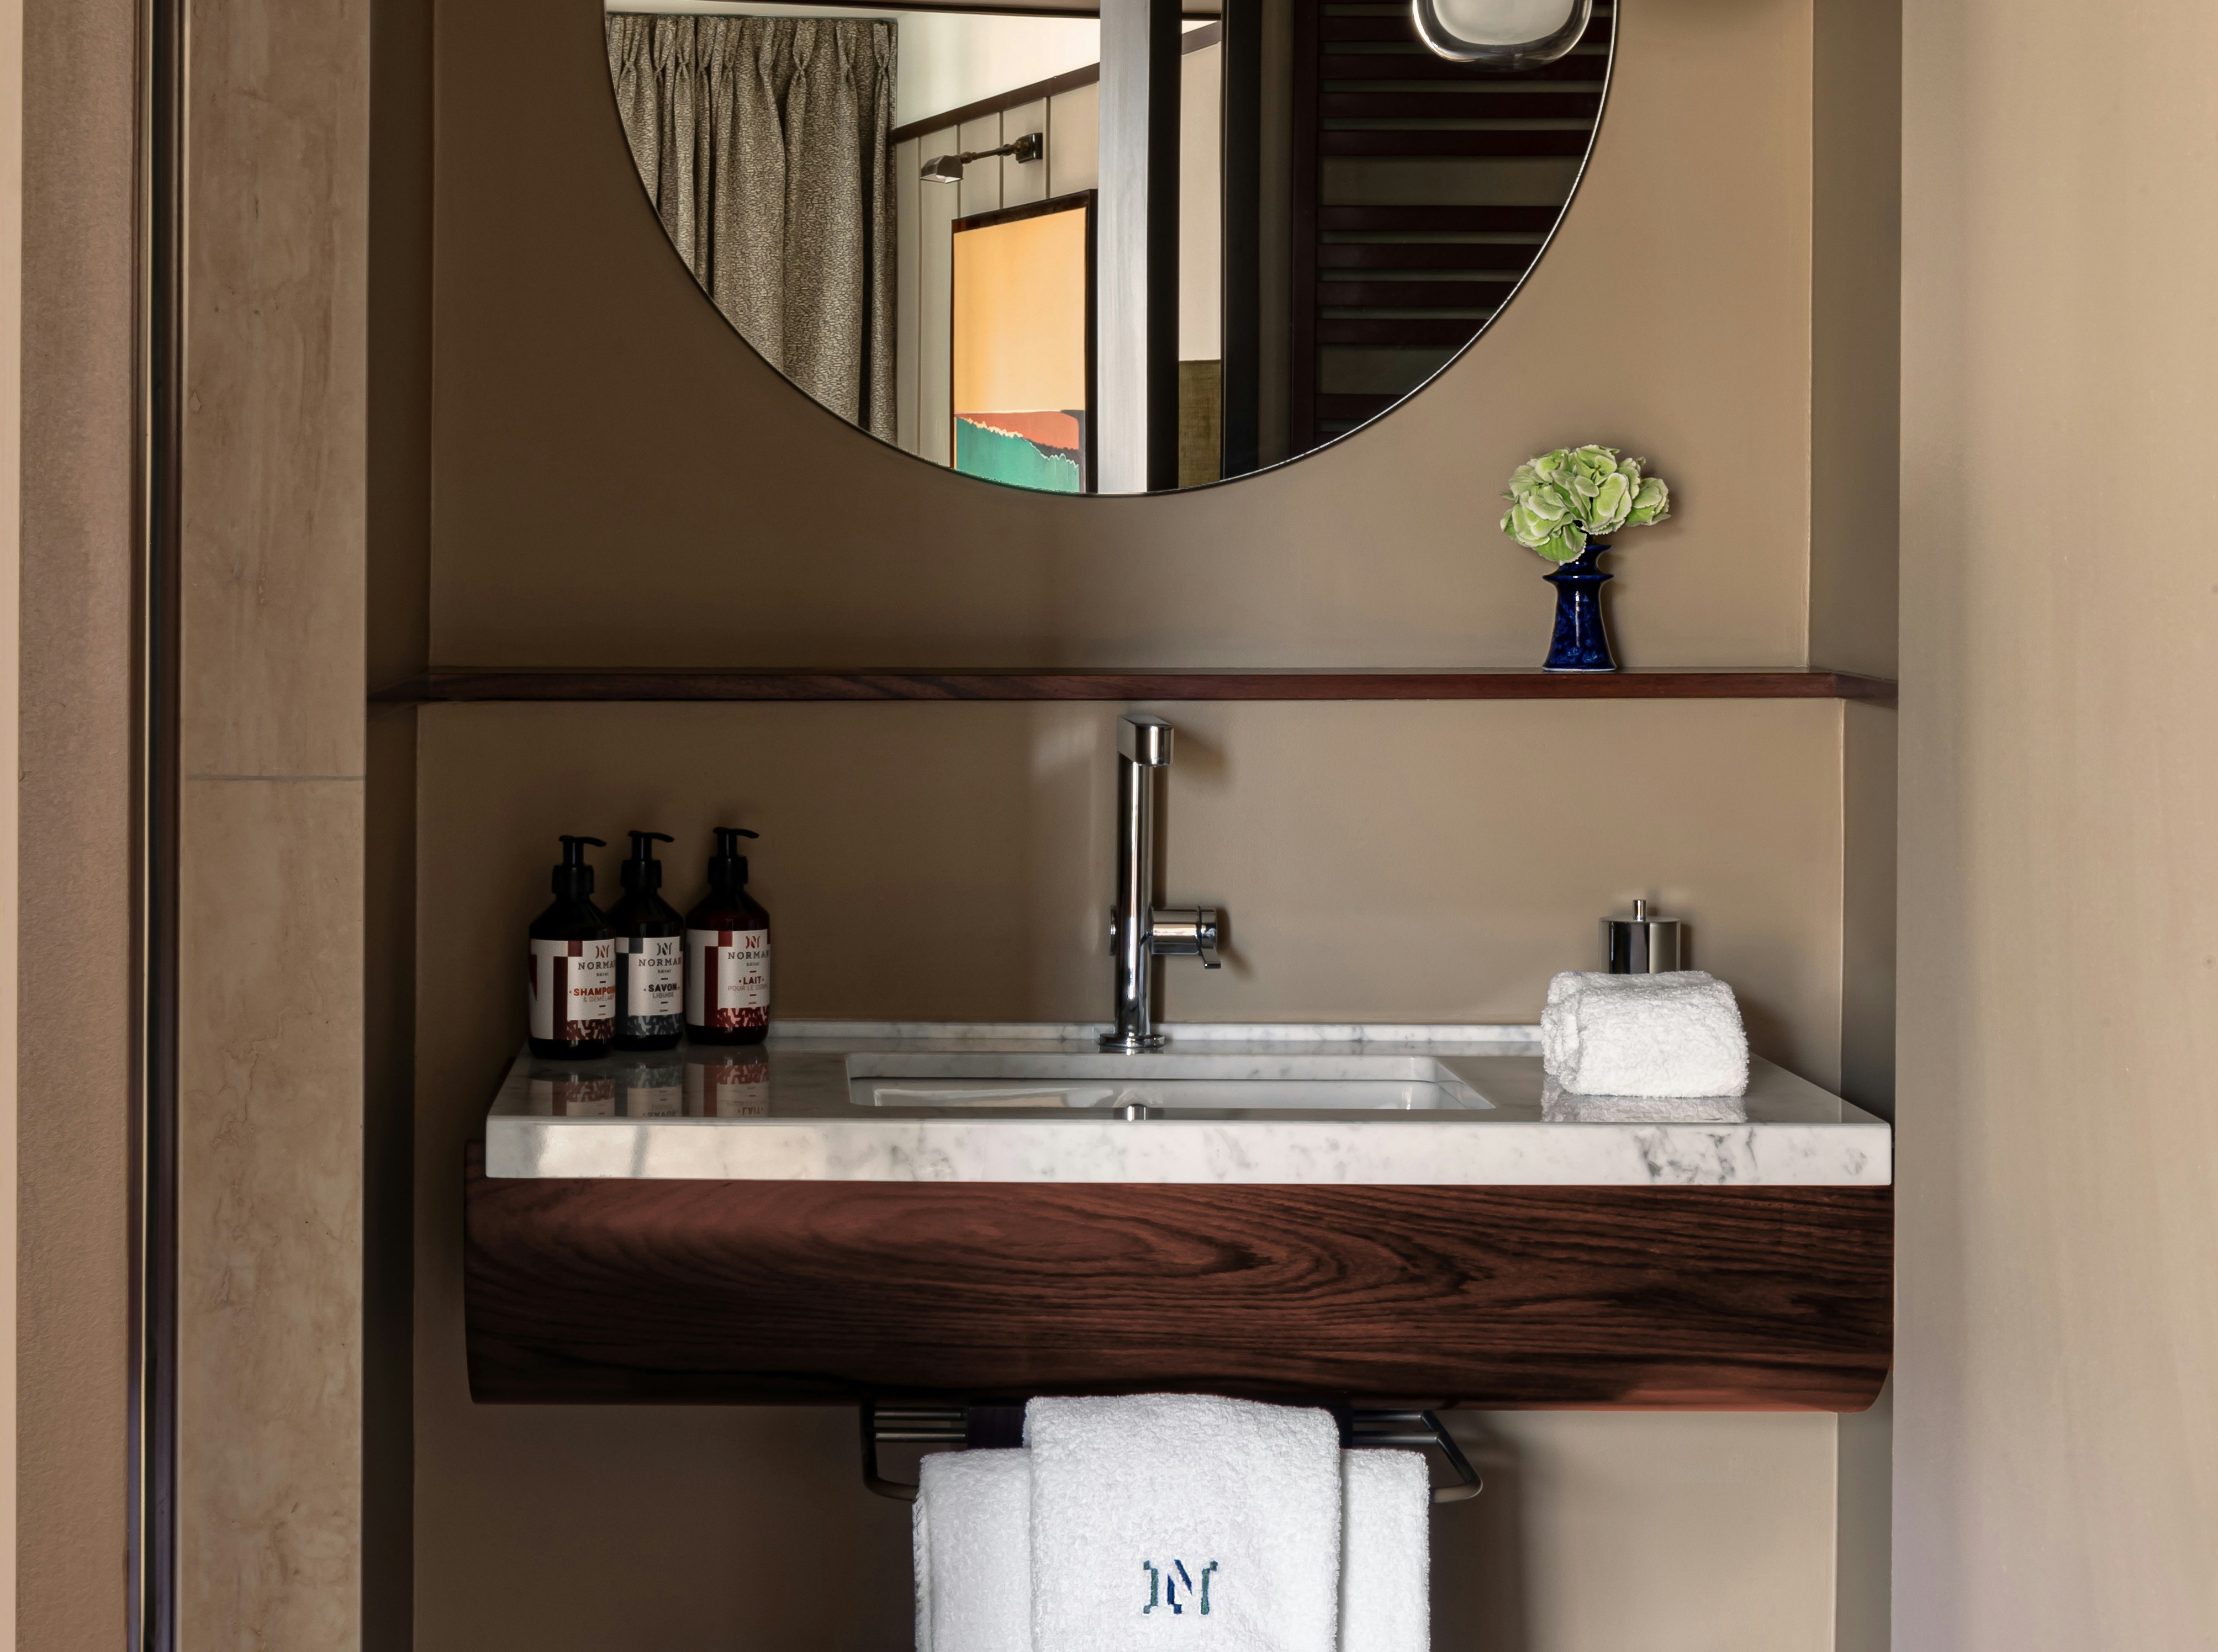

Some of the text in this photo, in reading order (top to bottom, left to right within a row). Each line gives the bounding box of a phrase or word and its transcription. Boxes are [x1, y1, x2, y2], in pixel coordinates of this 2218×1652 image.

[578, 960, 615, 970] NORMA
[743, 976, 762, 984] LAIT
[648, 984, 677, 992] SAVON
